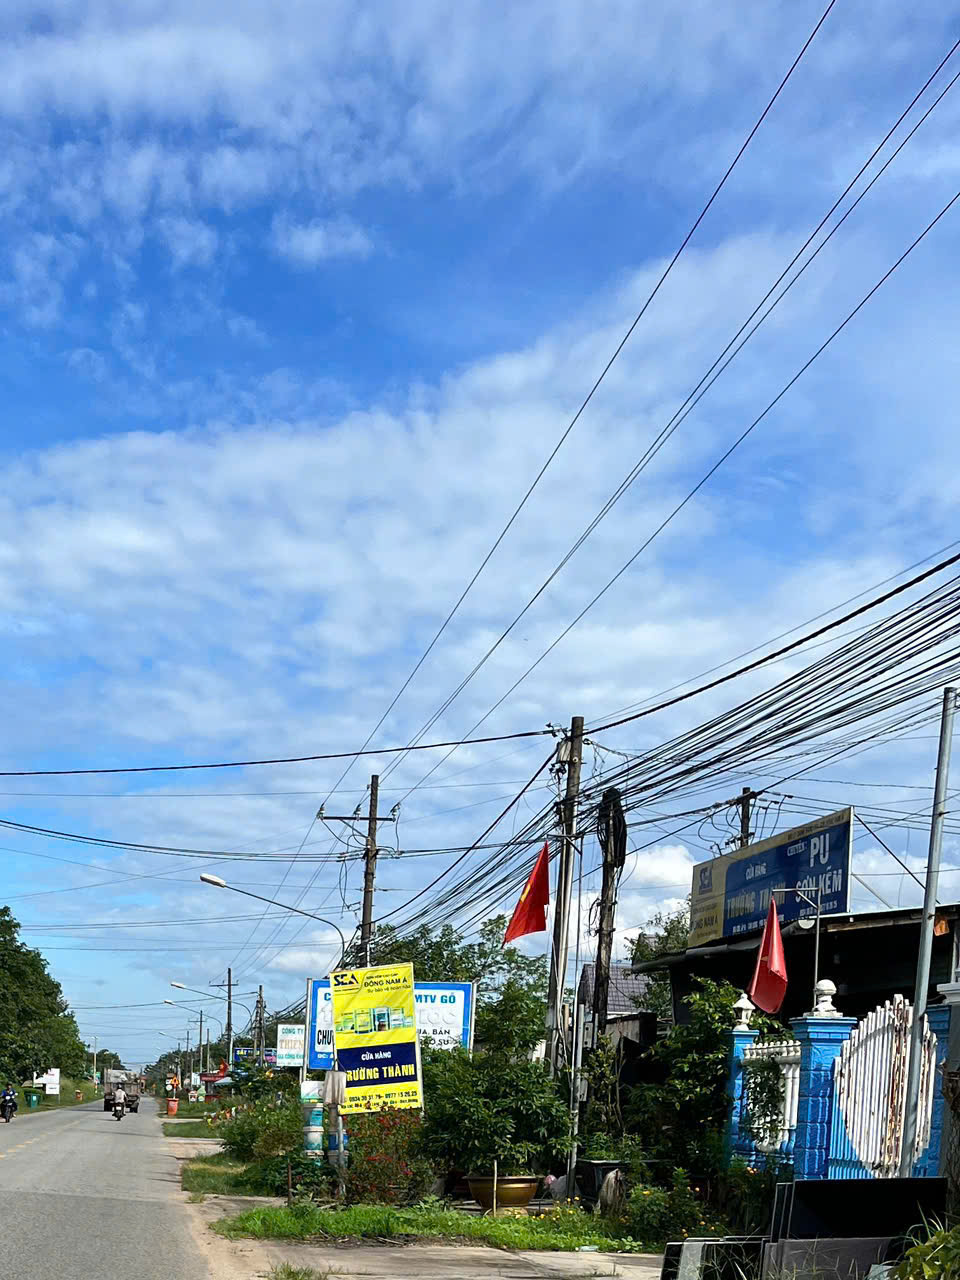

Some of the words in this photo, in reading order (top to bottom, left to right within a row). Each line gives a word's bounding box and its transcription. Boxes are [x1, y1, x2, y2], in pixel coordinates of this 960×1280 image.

[809, 833, 830, 868] PU
[795, 875, 816, 903] SƠN
[818, 866, 843, 896] KẼM
[333, 973, 359, 987] SEA
[374, 1050, 392, 1060] HÀNG
[345, 1066, 380, 1081] RƯỜNG
[382, 1063, 415, 1078] THÀNH
